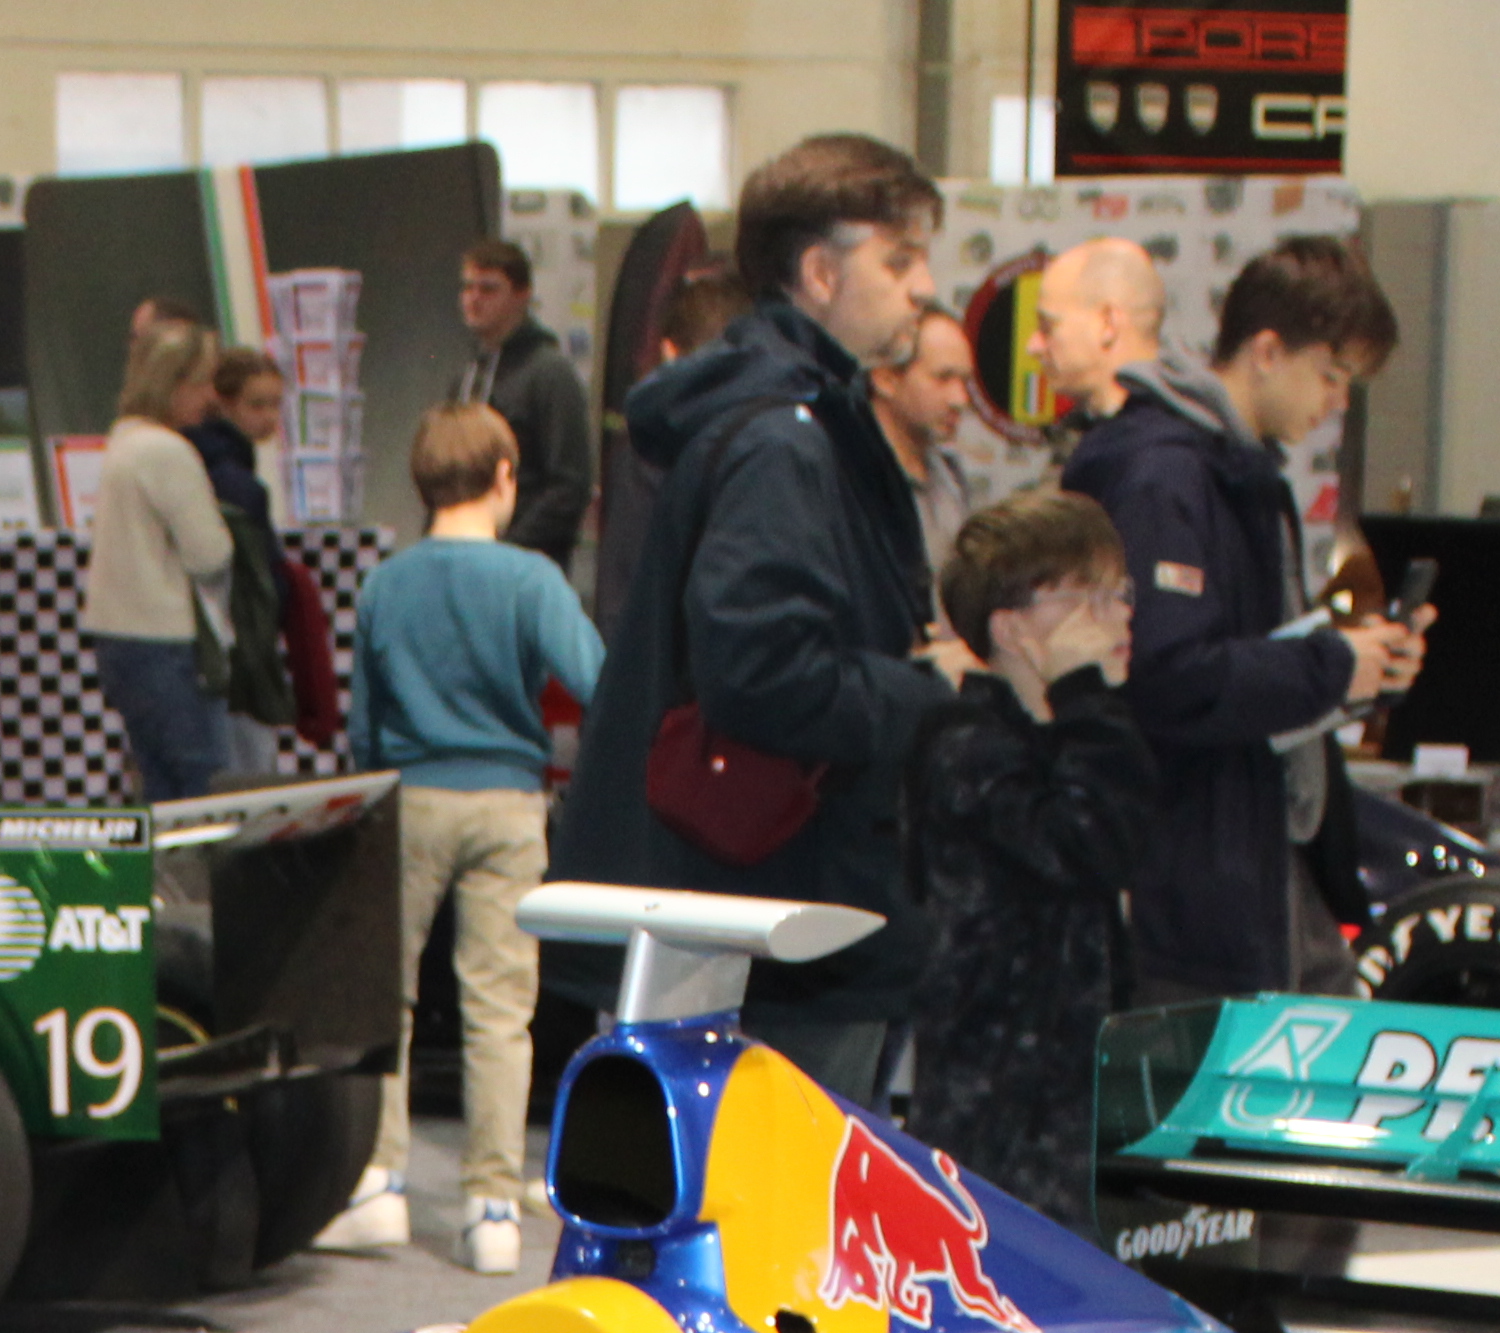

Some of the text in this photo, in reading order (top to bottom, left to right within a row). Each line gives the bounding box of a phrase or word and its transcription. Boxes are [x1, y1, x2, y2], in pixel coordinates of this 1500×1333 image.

[0, 817, 138, 842] MICHELIN
[49, 905, 151, 953] AT&T
[33, 1006, 144, 1119] 19
[1116, 1205, 1255, 1262] GOODYEAR
